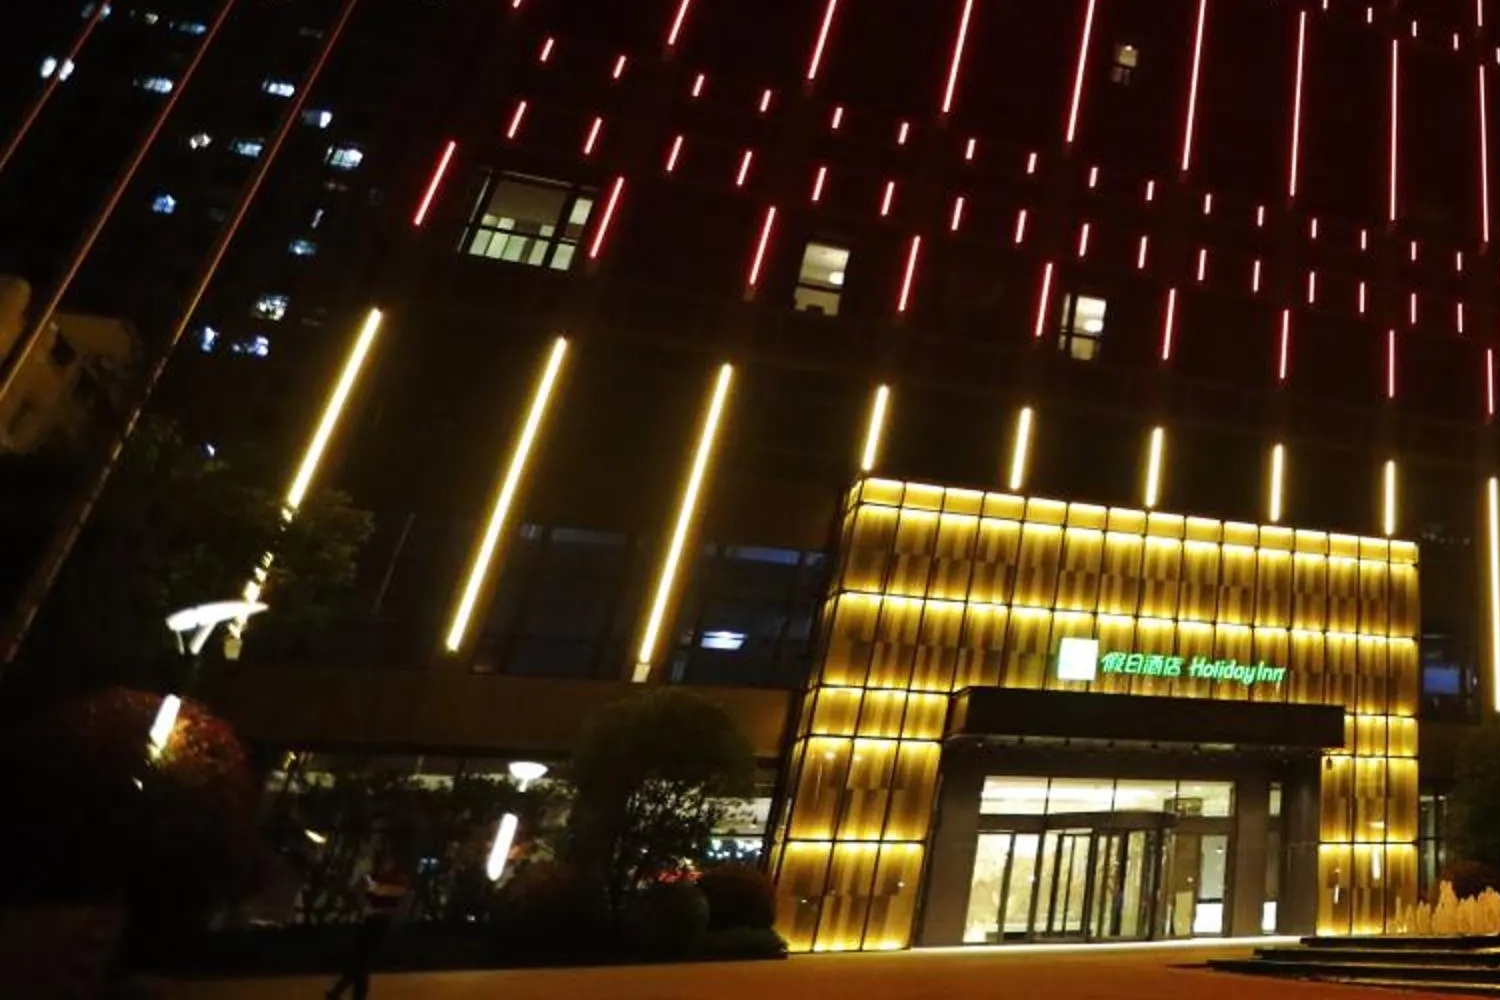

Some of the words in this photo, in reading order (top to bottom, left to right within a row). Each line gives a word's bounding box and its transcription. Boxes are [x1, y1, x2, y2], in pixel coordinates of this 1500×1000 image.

[1102, 652, 1183, 677] 假日酒店
[1189, 656, 1256, 684] Holiday
[1256, 661, 1286, 681] Inn
